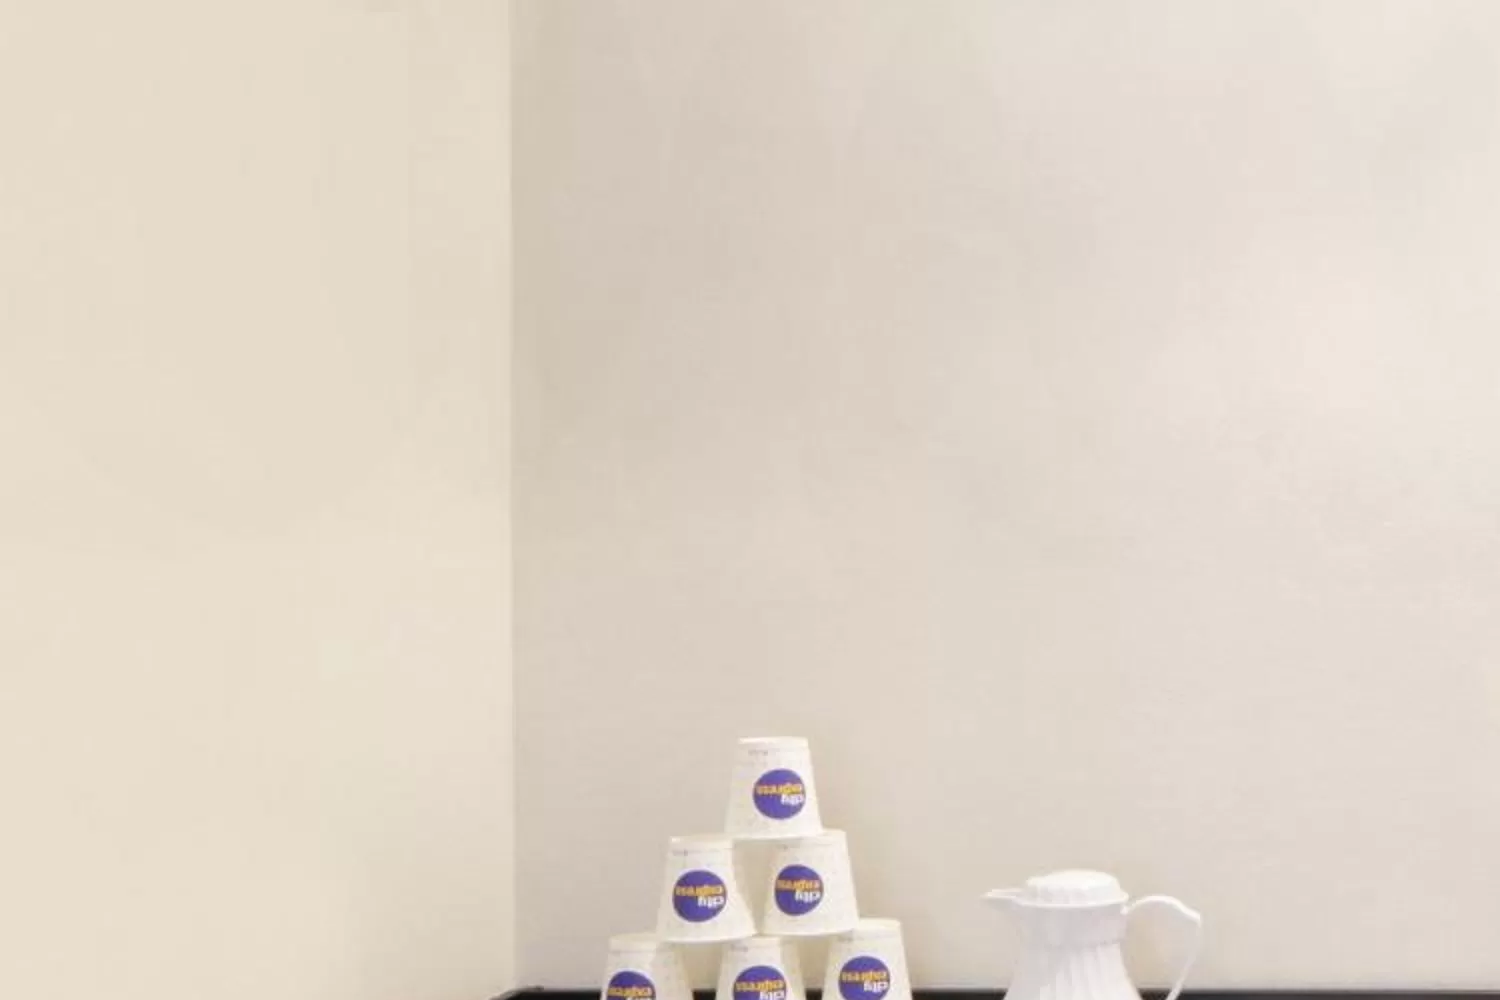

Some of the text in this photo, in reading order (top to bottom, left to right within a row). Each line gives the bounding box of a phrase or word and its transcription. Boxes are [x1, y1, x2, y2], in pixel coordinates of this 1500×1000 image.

[781, 794, 804, 807] city
[699, 895, 724, 909] city
[794, 890, 820, 903] city
[863, 981, 888, 992] city
